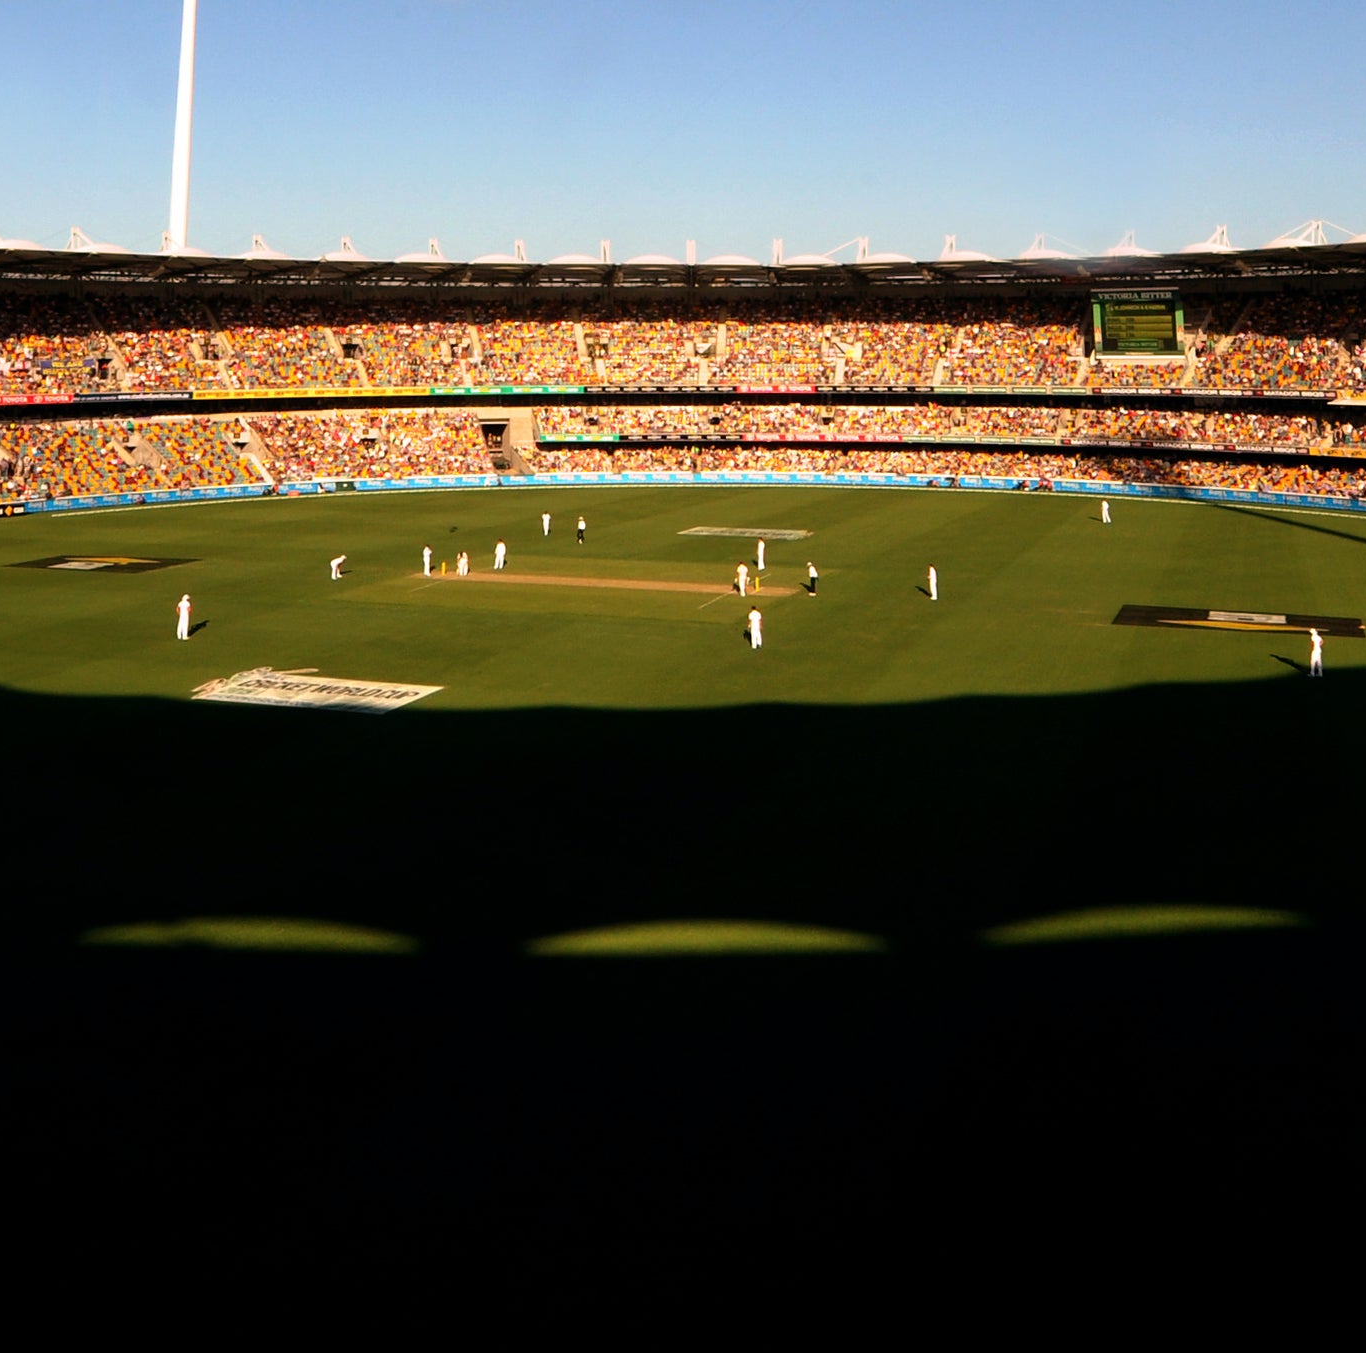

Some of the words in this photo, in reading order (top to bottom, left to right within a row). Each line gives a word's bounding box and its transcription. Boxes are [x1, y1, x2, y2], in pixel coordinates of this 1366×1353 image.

[1098, 292, 1138, 300] VICTORIA
[1141, 291, 1172, 299] BITTER
[237, 679, 320, 692] CRICKET
[310, 684, 382, 698] WORLD
[375, 690, 420, 699] CUP
